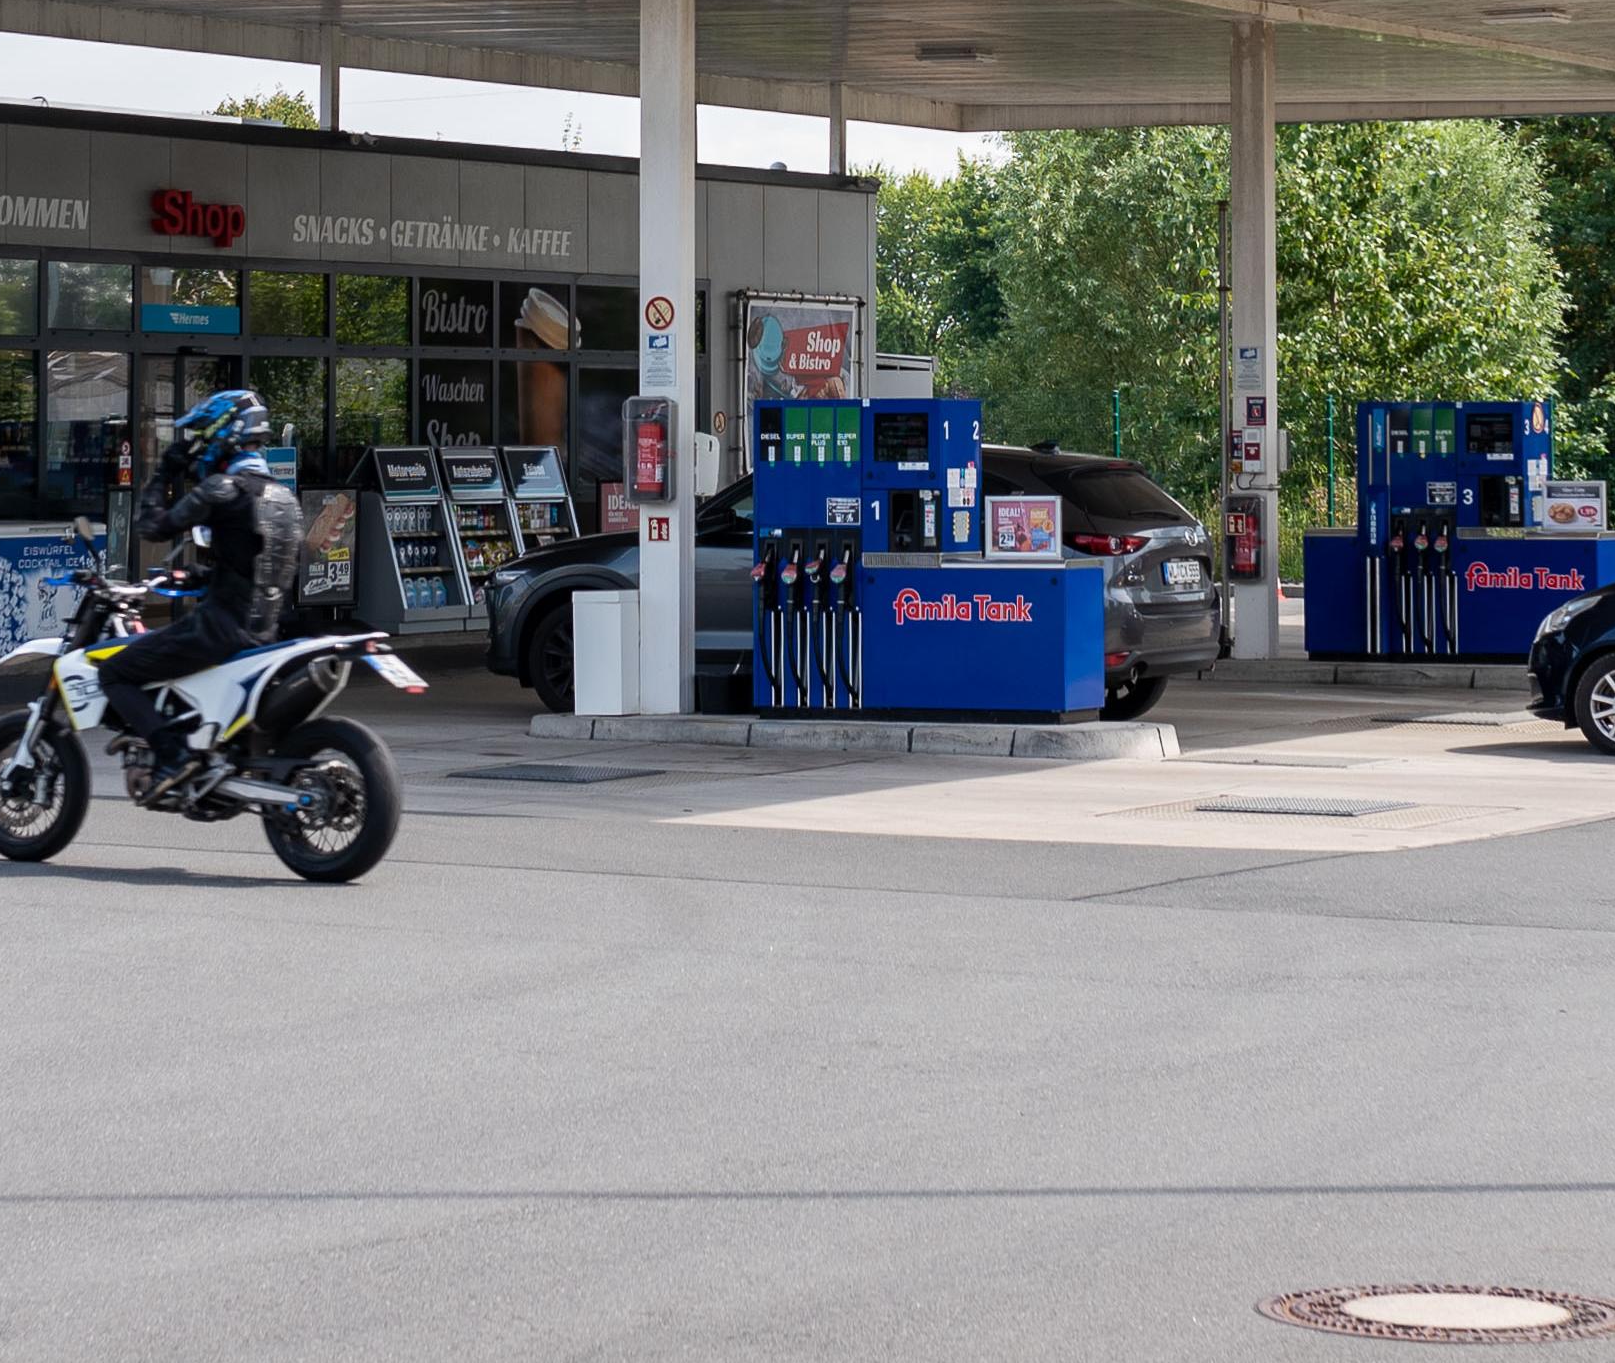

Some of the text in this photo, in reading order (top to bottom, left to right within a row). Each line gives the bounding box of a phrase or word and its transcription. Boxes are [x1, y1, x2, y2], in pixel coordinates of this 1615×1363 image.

[151, 189, 245, 248] Shop
[293, 214, 572, 257] SNACKS GETRÄNKE KAFFEE
[179, 313, 209, 326] Hermes
[422, 289, 488, 334] Bistro
[807, 331, 841, 358] Shop
[789, 353, 831, 370] & Bistro
[422, 374, 485, 403] Waschen
[944, 420, 979, 440] 1 2
[1524, 419, 1530, 435] 3
[1463, 489, 1473, 505] 3
[871, 500, 880, 521] 1
[23, 544, 75, 557] EISWÜRFEL
[18, 557, 62, 569] COCKTAIL
[1465, 561, 1585, 591] famila Tank
[893, 588, 1032, 626] famila Tank
